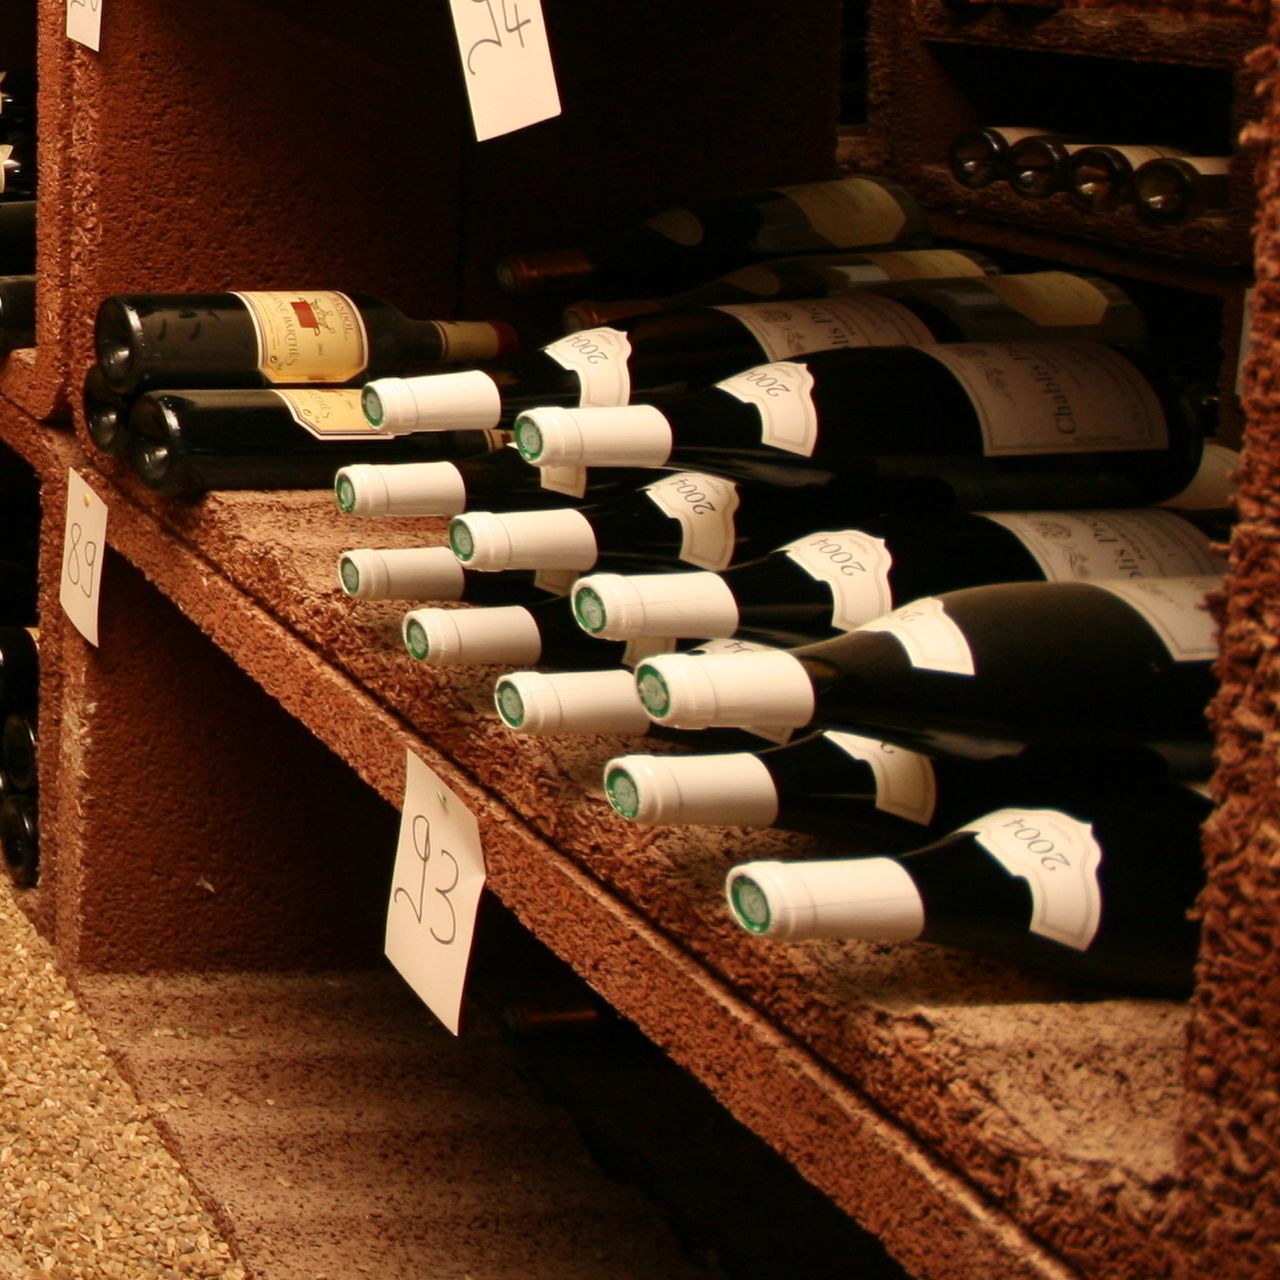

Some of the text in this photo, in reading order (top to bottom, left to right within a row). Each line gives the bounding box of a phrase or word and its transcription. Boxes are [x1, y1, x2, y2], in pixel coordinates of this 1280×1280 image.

[565, 334, 609, 365] 2004
[668, 478, 717, 515] 2004
[68, 523, 97, 598] 89
[807, 536, 867, 577] 2004
[1001, 816, 1071, 872] 2004
[393, 814, 460, 945] 93
